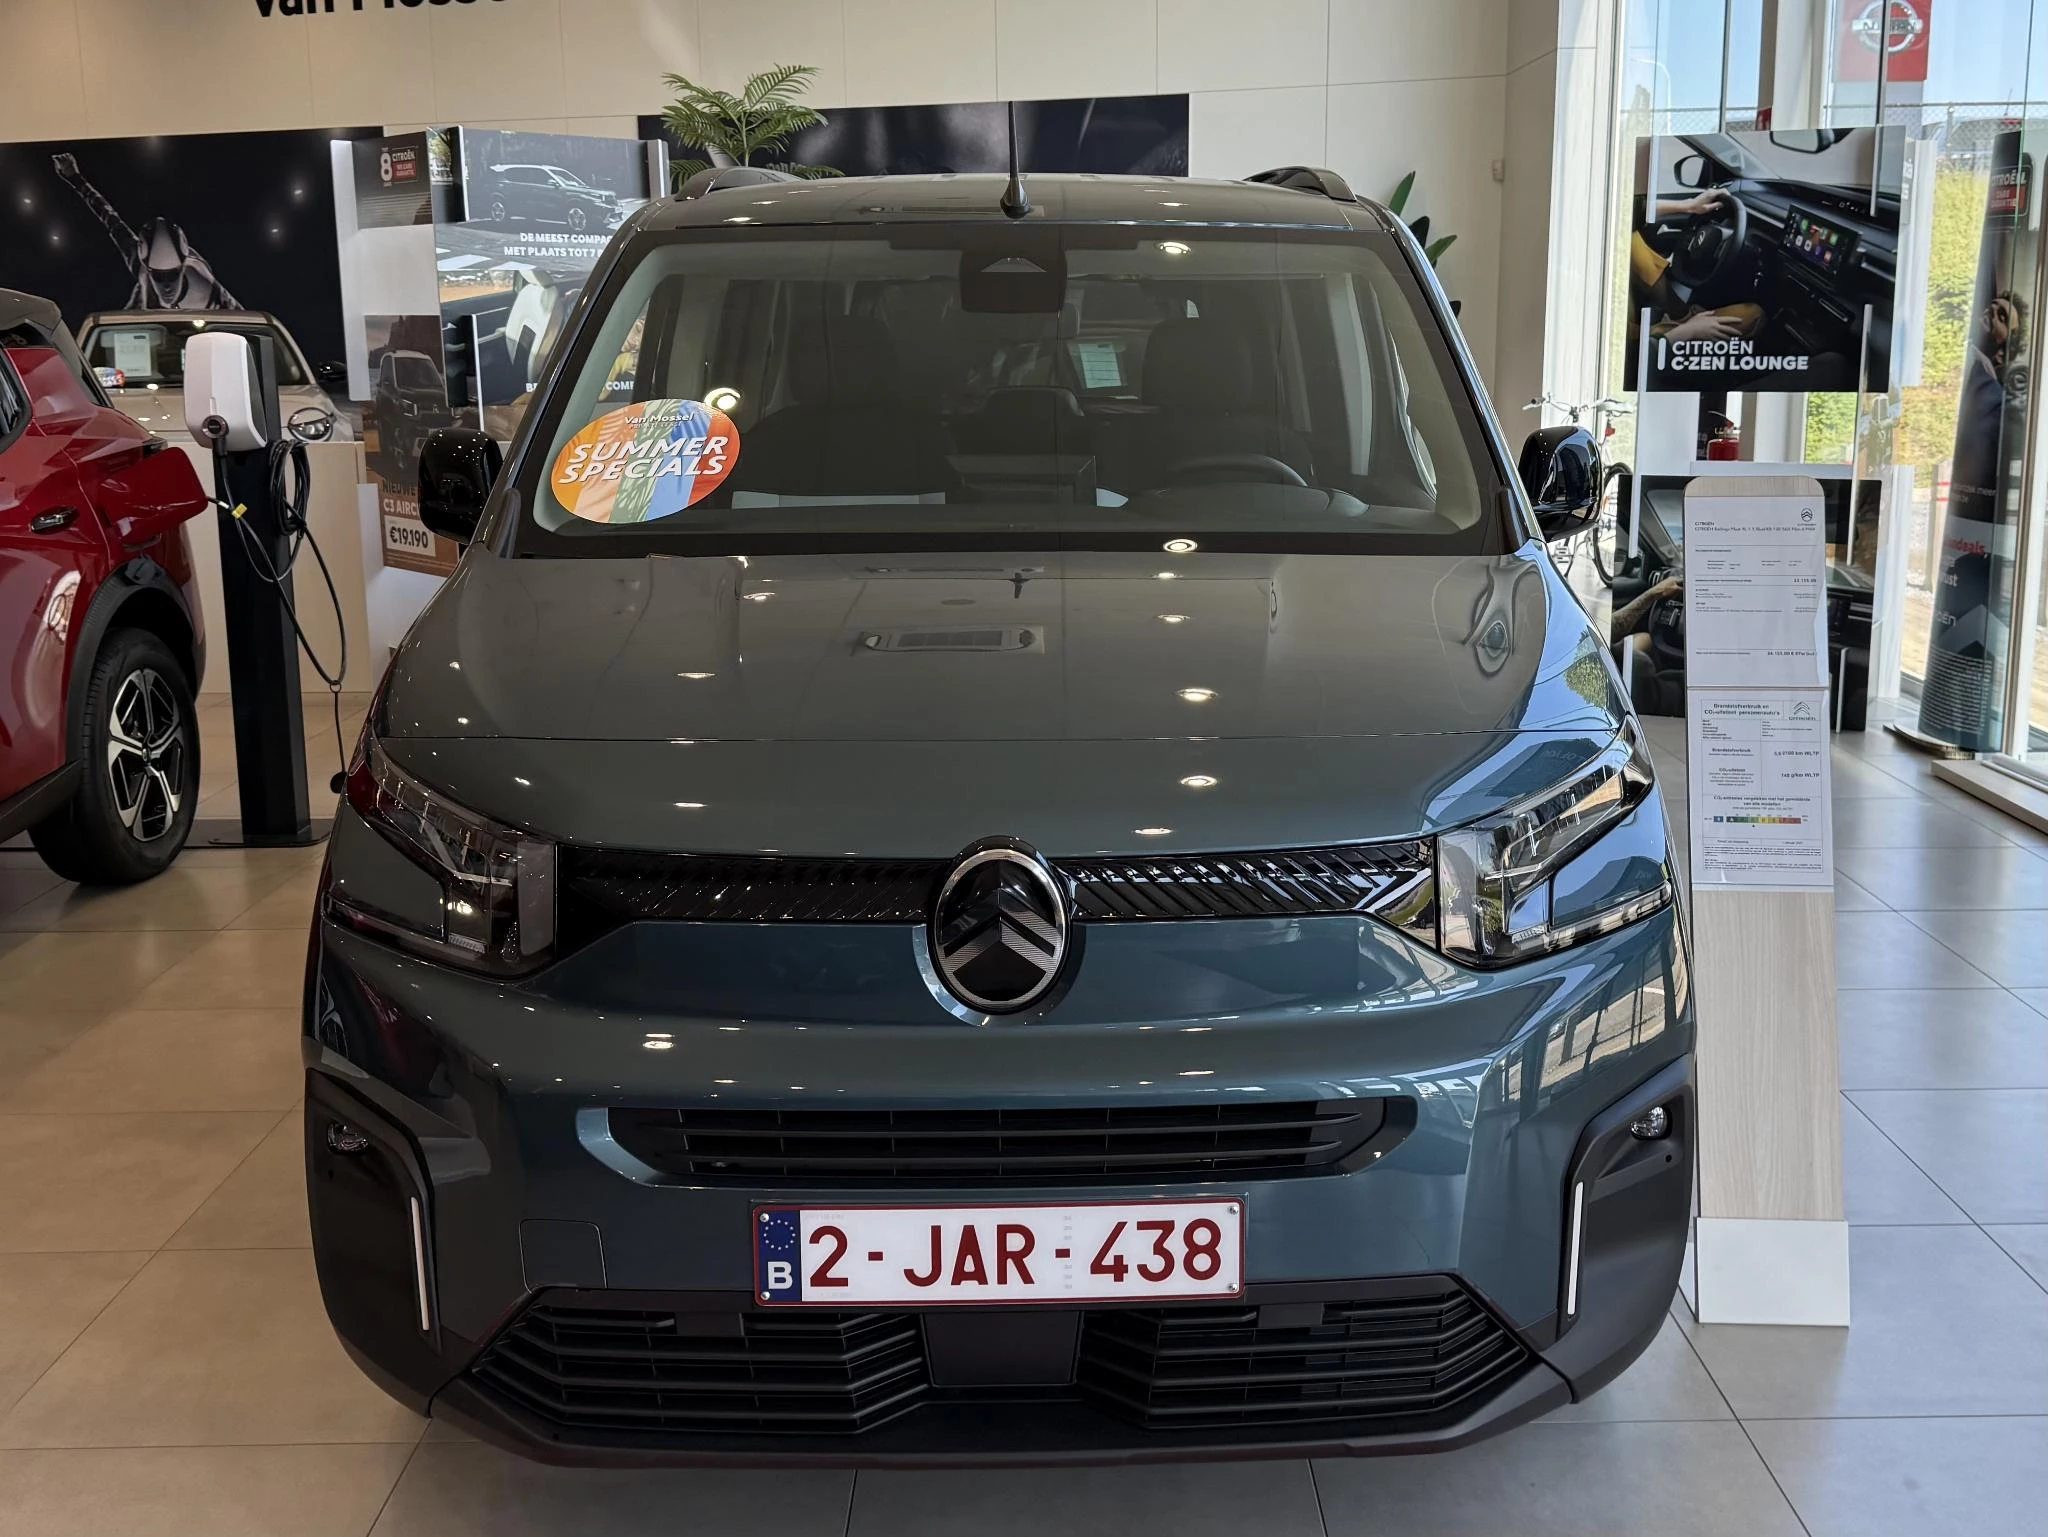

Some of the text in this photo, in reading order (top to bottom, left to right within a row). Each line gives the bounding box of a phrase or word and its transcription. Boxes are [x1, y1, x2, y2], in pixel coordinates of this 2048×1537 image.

[392, 149, 416, 161] CITROËN
[381, 152, 392, 182] 8
[520, 232, 535, 242] DE
[536, 233, 569, 243] MEEST
[504, 246, 526, 256] MET
[528, 247, 567, 257] PLAATS
[568, 248, 589, 258] TOT
[590, 248, 596, 258] 7
[1671, 336, 1754, 355] CITROËN
[1671, 355, 1809, 371] C-ZEN LOUNGE
[624, 411, 695, 424] Van Mossel
[568, 435, 729, 464] SUMMER
[558, 454, 728, 485] SPECIALS
[383, 498, 395, 513] C3
[389, 525, 429, 549] €19.190
[767, 1261, 794, 1290] B
